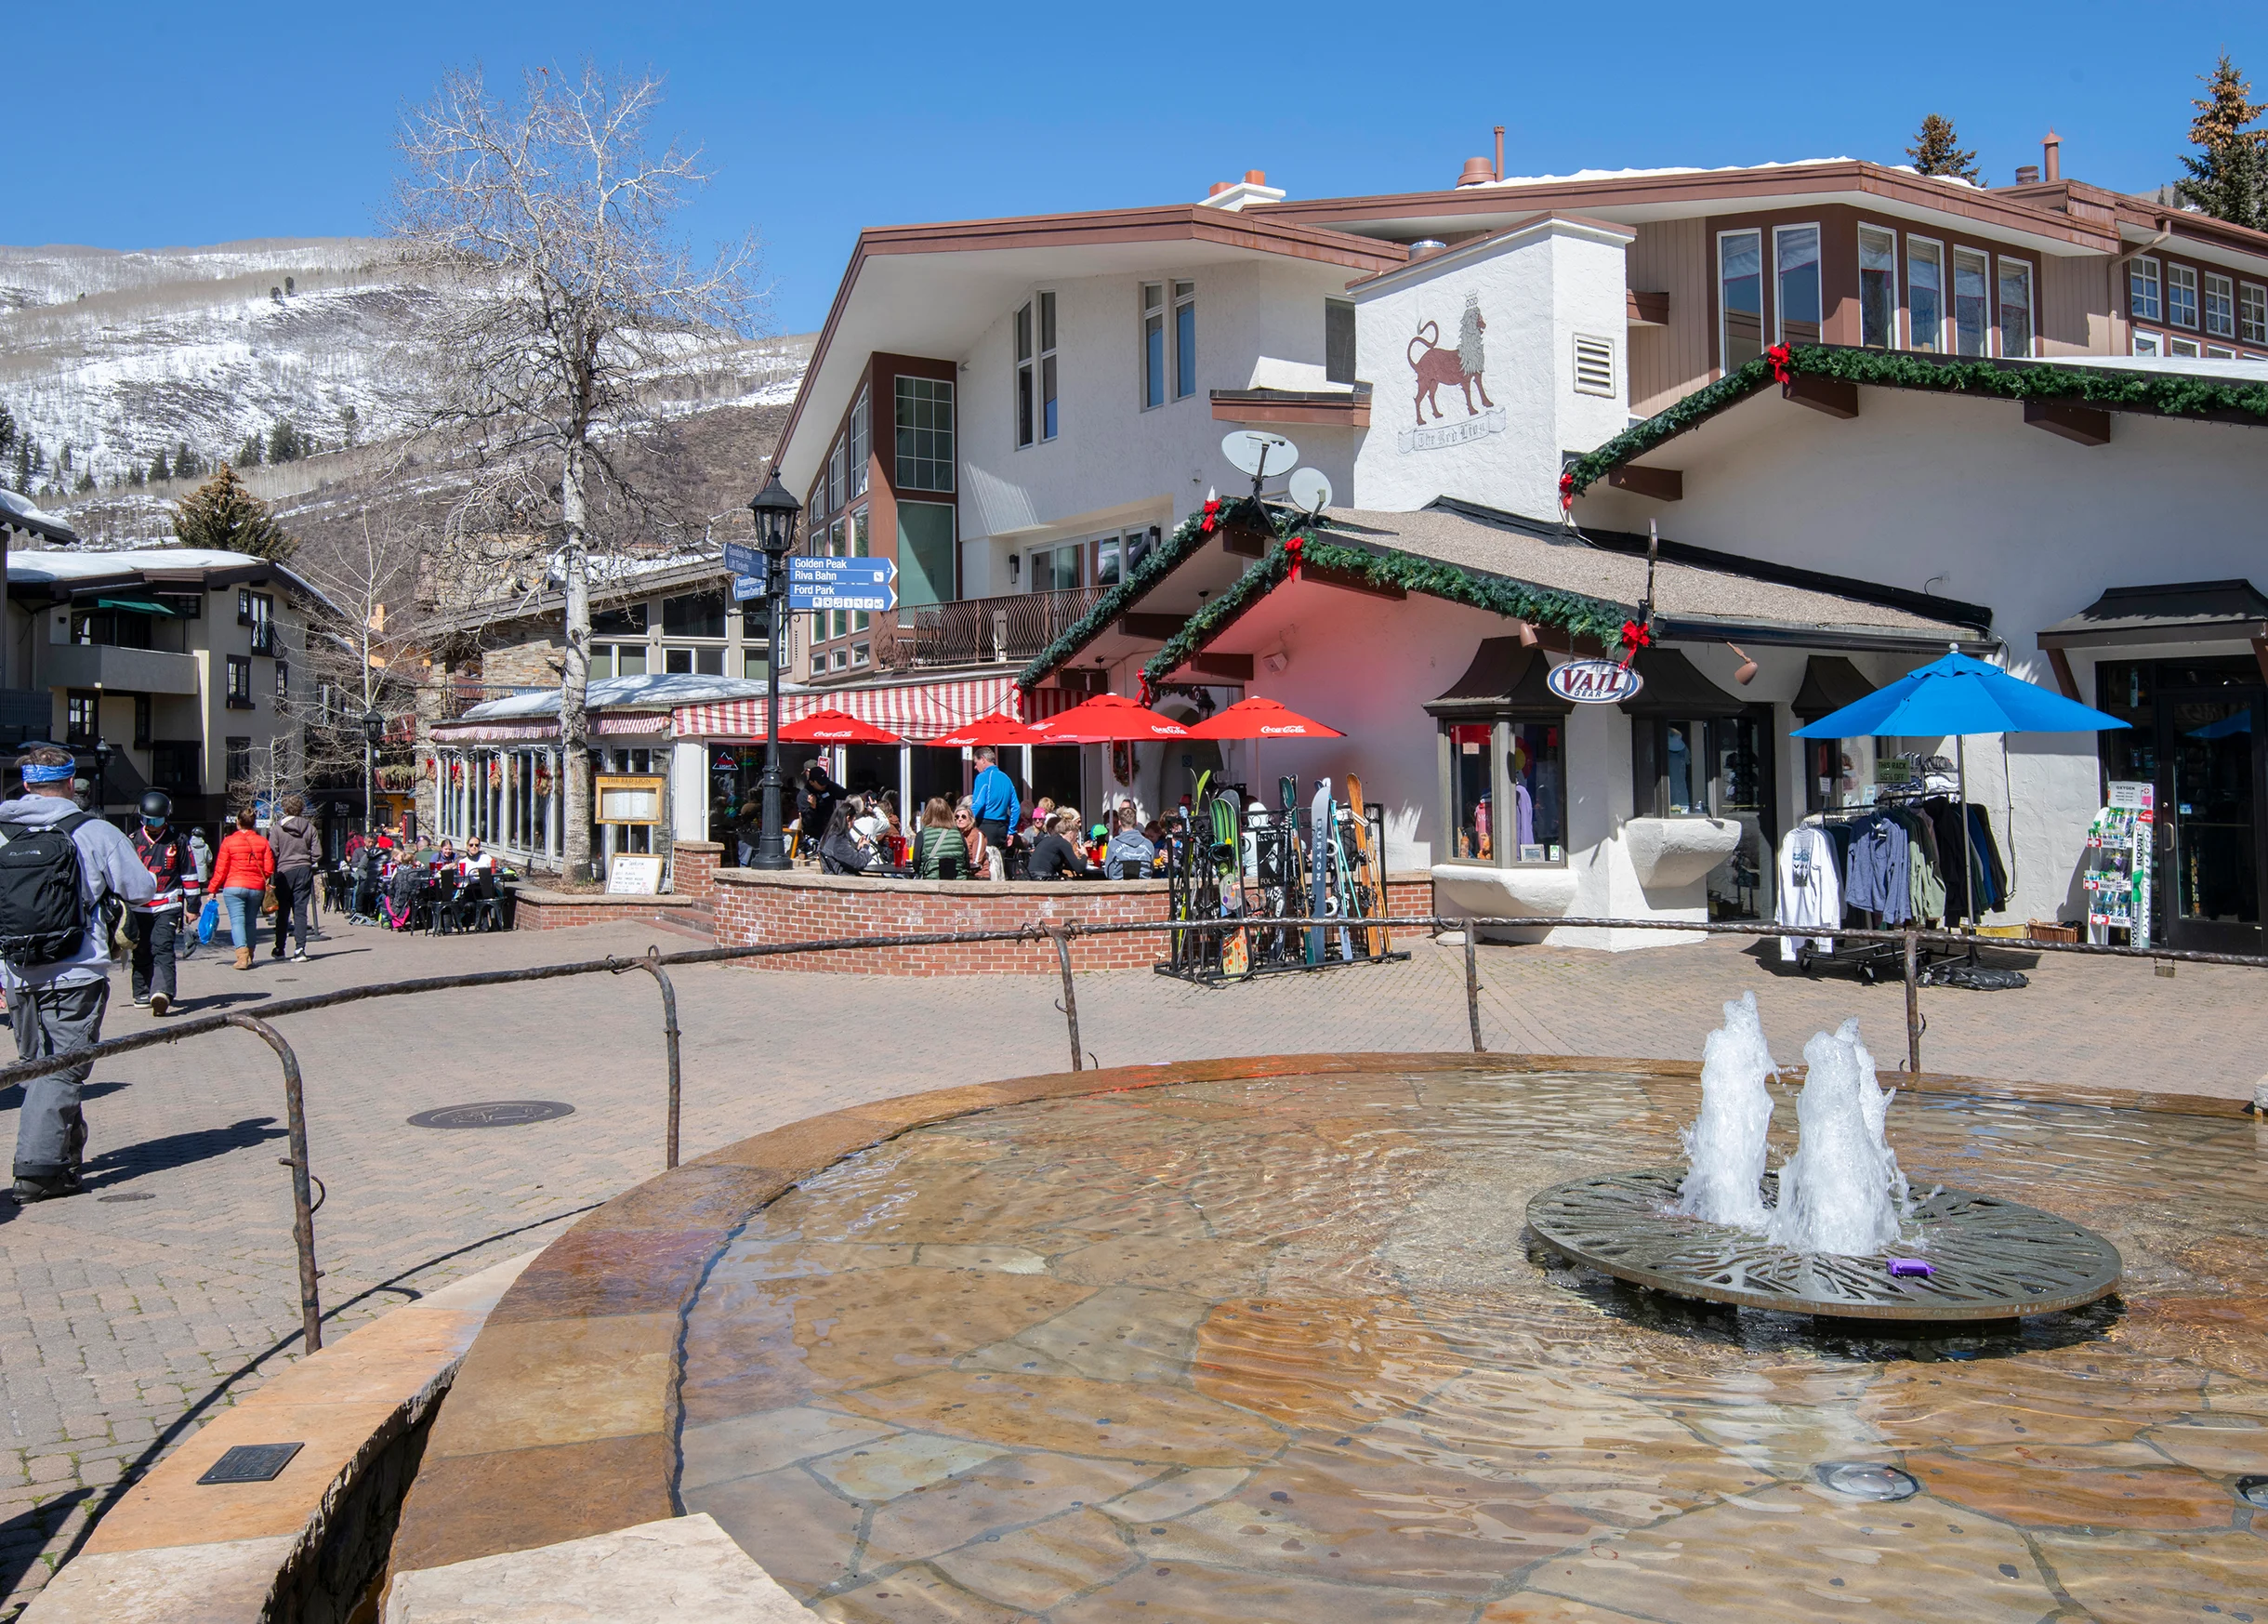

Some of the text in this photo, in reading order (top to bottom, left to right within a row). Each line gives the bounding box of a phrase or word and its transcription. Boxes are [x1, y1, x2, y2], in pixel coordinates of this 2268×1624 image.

[1418, 433, 1435, 447] The
[795, 559, 847, 568] Golden Peak
[795, 570, 837, 580] Riva Bahn
[794, 585, 835, 595] Ford Park
[1563, 669, 1623, 693] VAIL
[1152, 725, 1189, 734] Coca-Cola
[1260, 725, 1307, 733] Coca-Cola
[2142, 877, 2151, 939] OXYGEN
